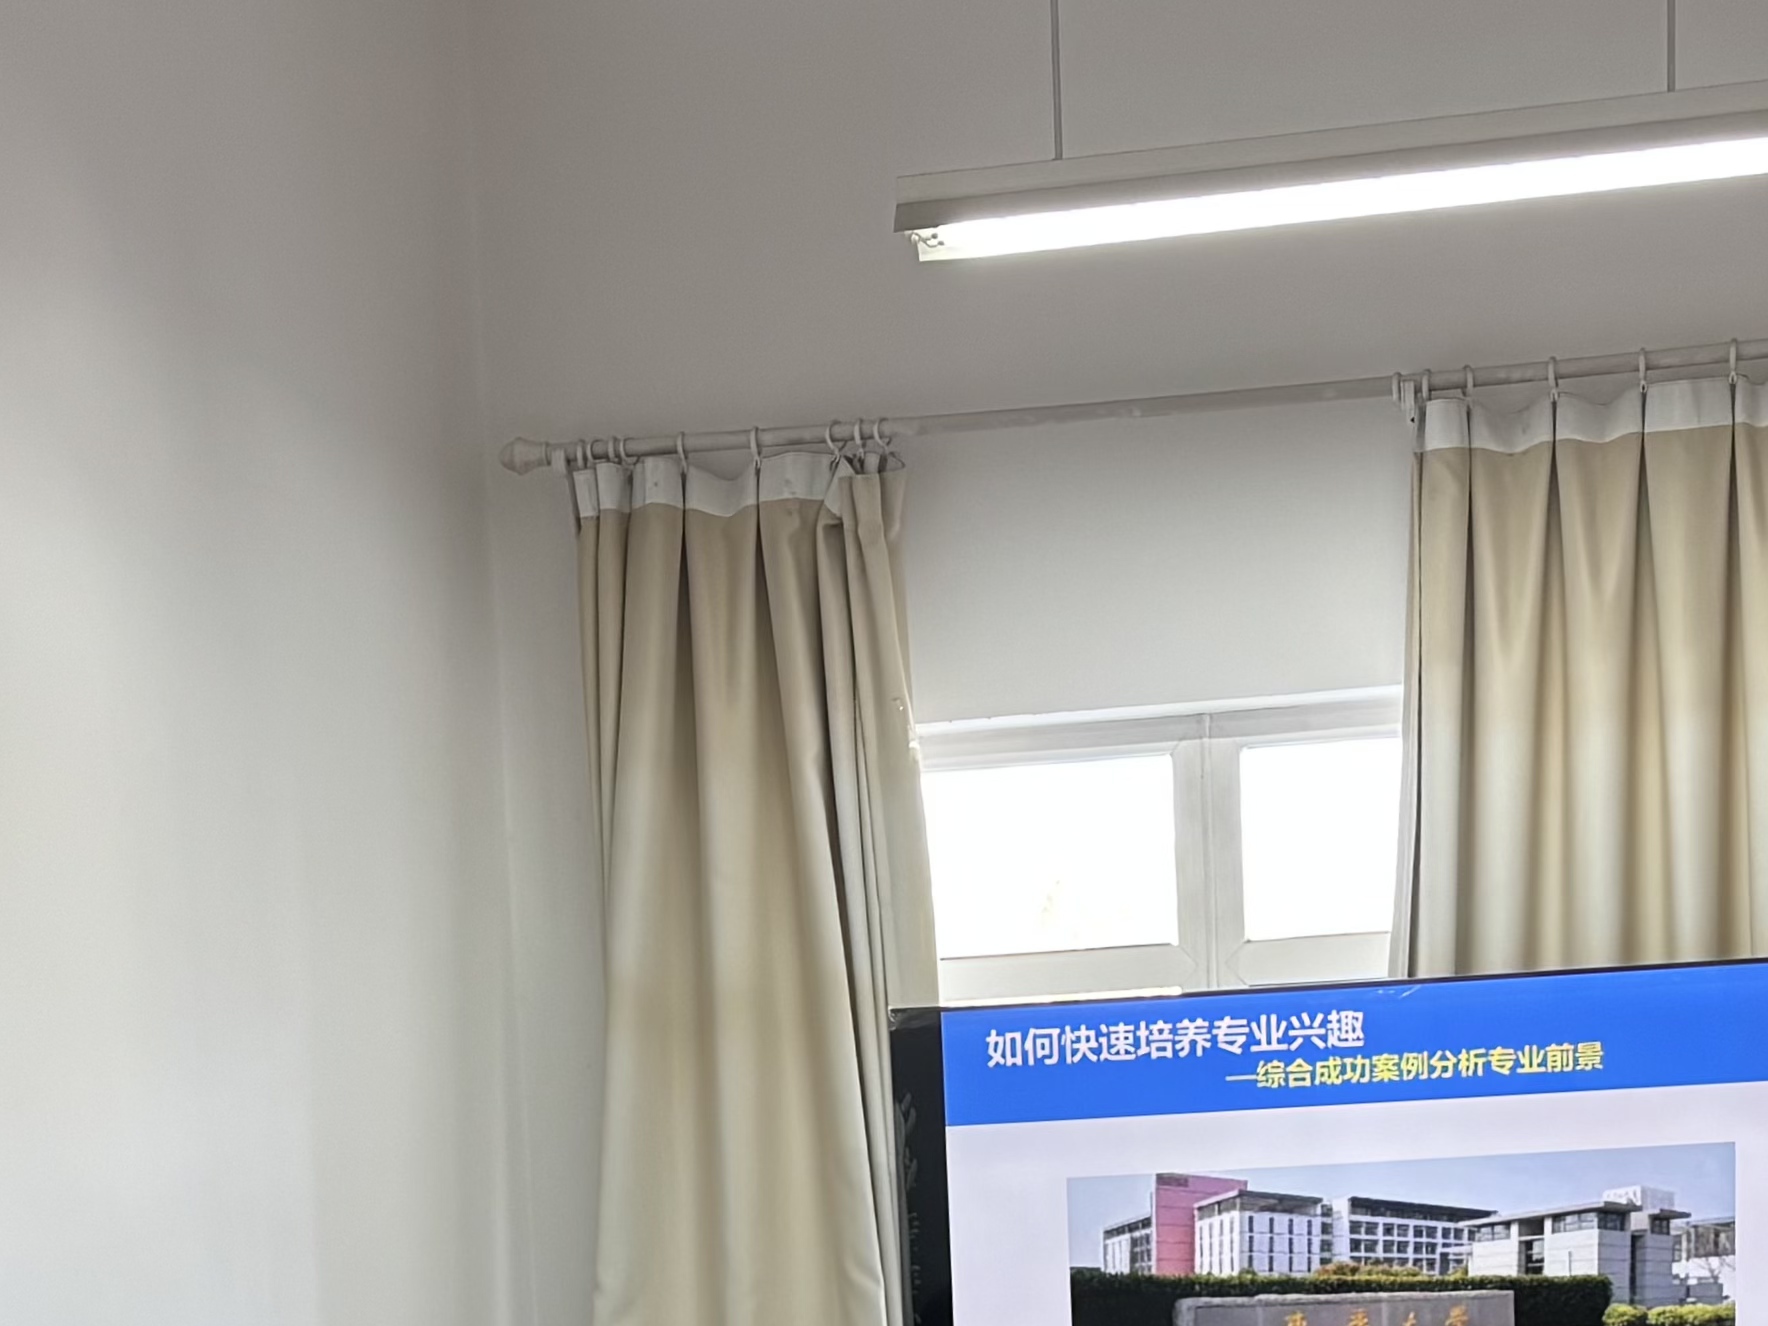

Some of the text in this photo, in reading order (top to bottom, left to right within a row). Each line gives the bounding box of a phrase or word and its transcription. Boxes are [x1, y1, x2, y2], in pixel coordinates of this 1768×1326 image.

[985, 1010, 1365, 1068] 如何快速培养专业兴趣
